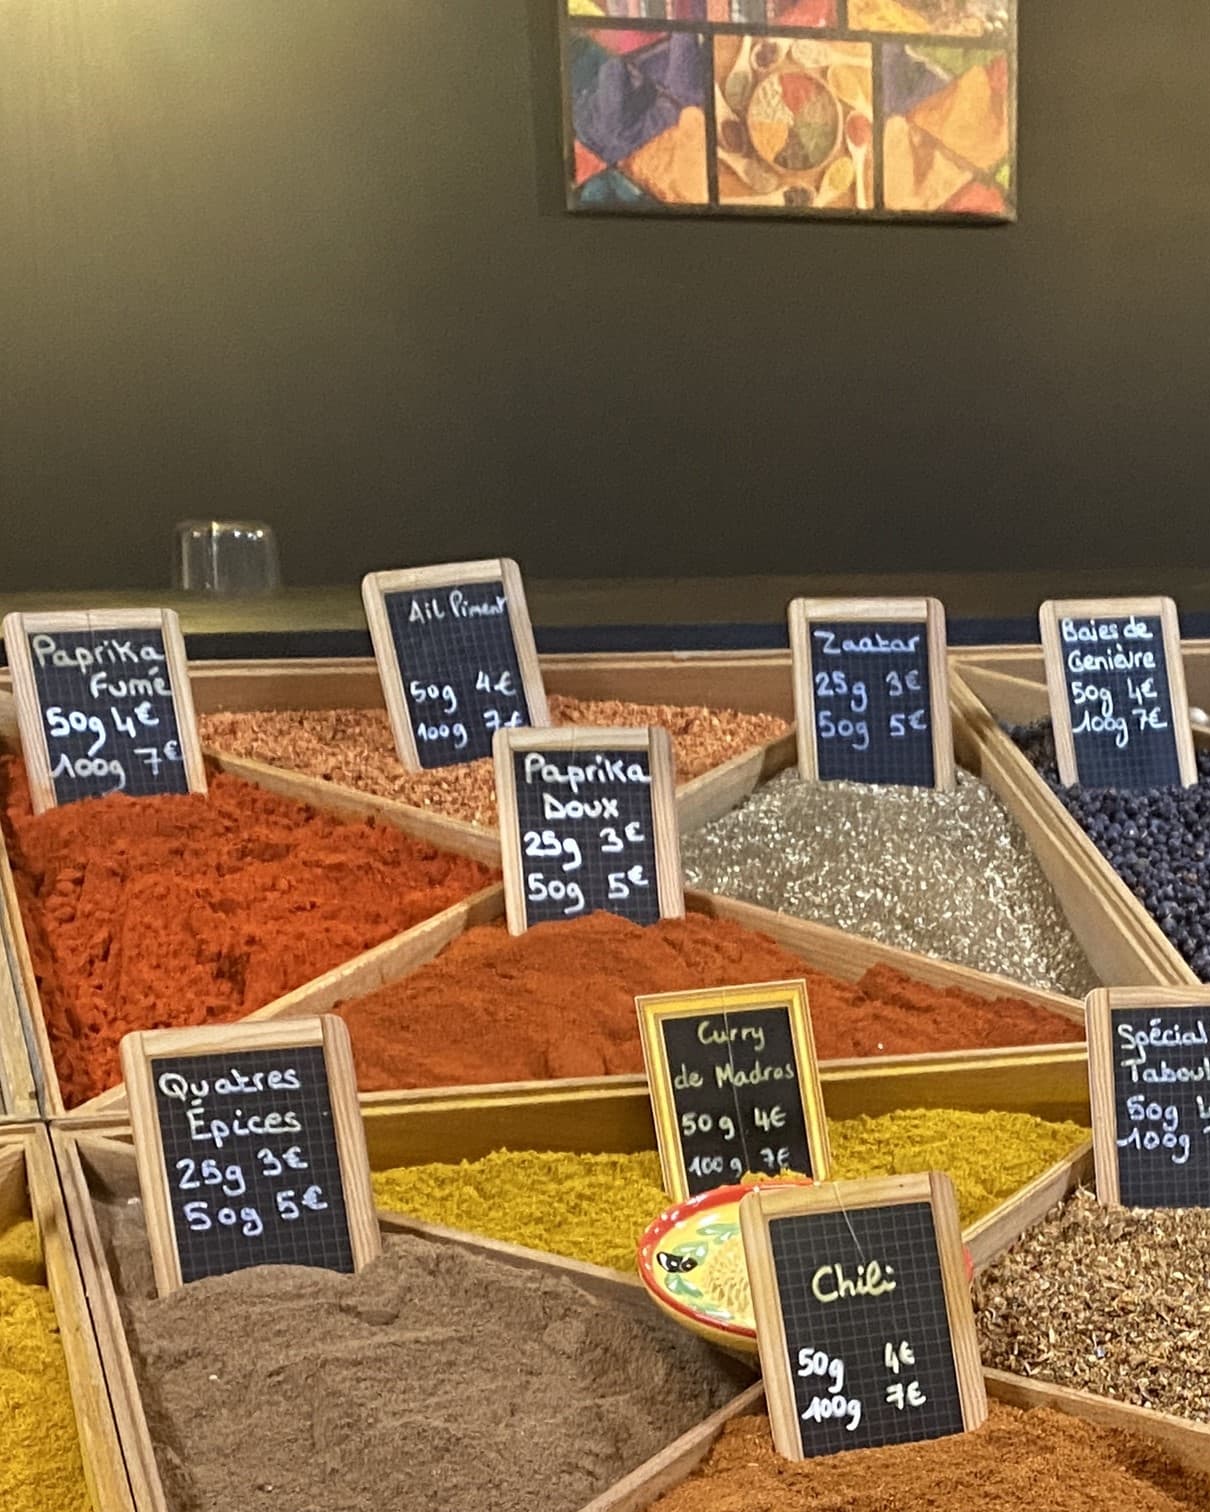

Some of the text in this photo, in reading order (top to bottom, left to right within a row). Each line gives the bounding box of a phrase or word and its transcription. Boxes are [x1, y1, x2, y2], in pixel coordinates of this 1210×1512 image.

[409, 590, 506, 624] Ail Piment
[814, 631, 920, 654] Zaatar
[1062, 616, 1153, 642] Baies de
[33, 635, 165, 674] Paprika
[1068, 643, 1155, 672] Genièvre
[410, 671, 516, 714] 50g 4€
[815, 670, 921, 712] 25g 3€
[1071, 678, 1157, 717] 50g 4€
[46, 701, 159, 757] 50g 4€
[417, 722, 467, 749] 100g
[818, 710, 927, 750] 50g 5€
[1072, 707, 1167, 748] 100g 7€
[51, 740, 183, 796] 100g 7€
[525, 753, 652, 794] Paprika
[543, 792, 619, 820] Doux
[524, 821, 645, 871] 25g 3€
[528, 865, 648, 914] 50g 5€
[697, 1020, 765, 1051] Curry
[1118, 1017, 1208, 1063] Spécial
[158, 1068, 300, 1101] Quatres
[673, 1063, 704, 1090] de
[753, 1105, 787, 1132] 4€
[1126, 1094, 1179, 1132] 50g
[1116, 1126, 1190, 1164] 100g
[176, 1145, 309, 1197] 25g 3€
[183, 1184, 328, 1237] 50g 5€
[812, 1260, 896, 1303] Chili
[798, 1341, 915, 1394] 50g 4€
[801, 1380, 926, 1432] 100g 7€
